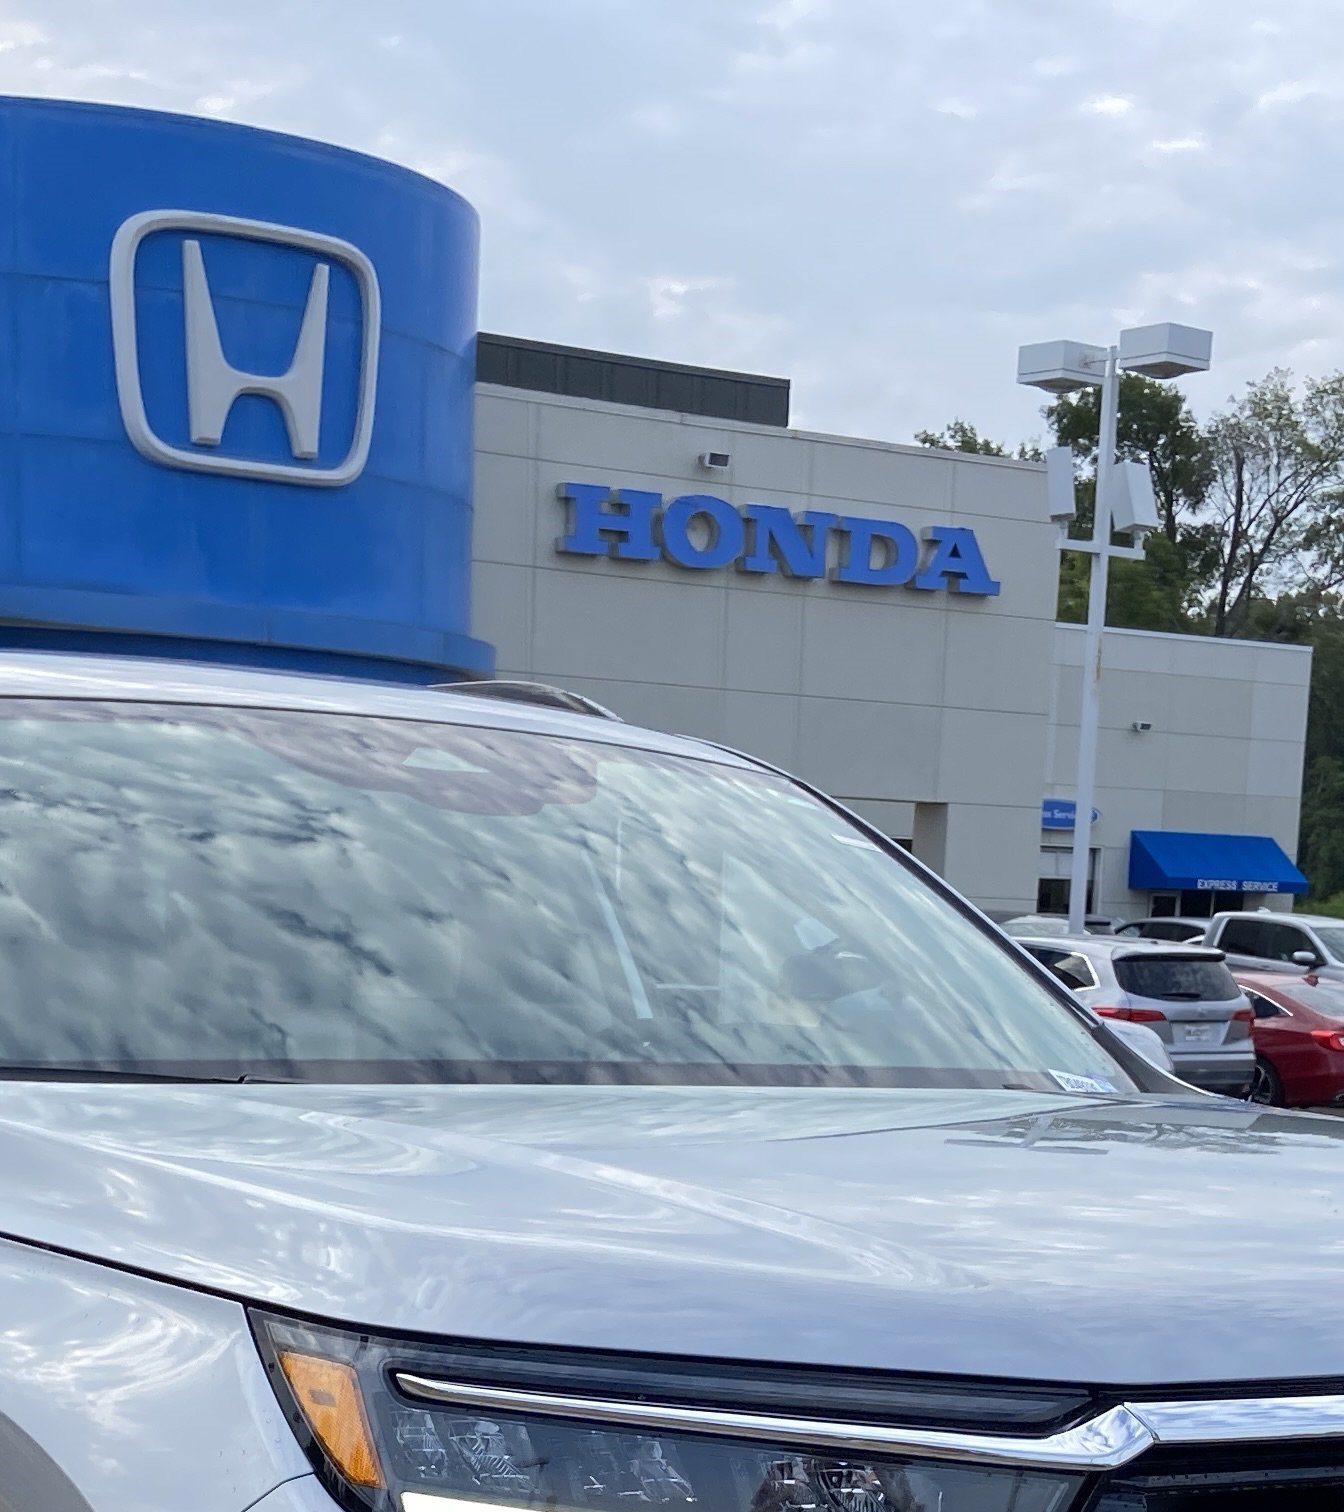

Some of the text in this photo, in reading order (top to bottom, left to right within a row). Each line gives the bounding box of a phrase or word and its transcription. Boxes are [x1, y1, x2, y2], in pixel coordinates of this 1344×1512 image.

[556, 482, 1001, 597] HONDA
[1197, 879, 1279, 892] EXPRESS SERVICE
